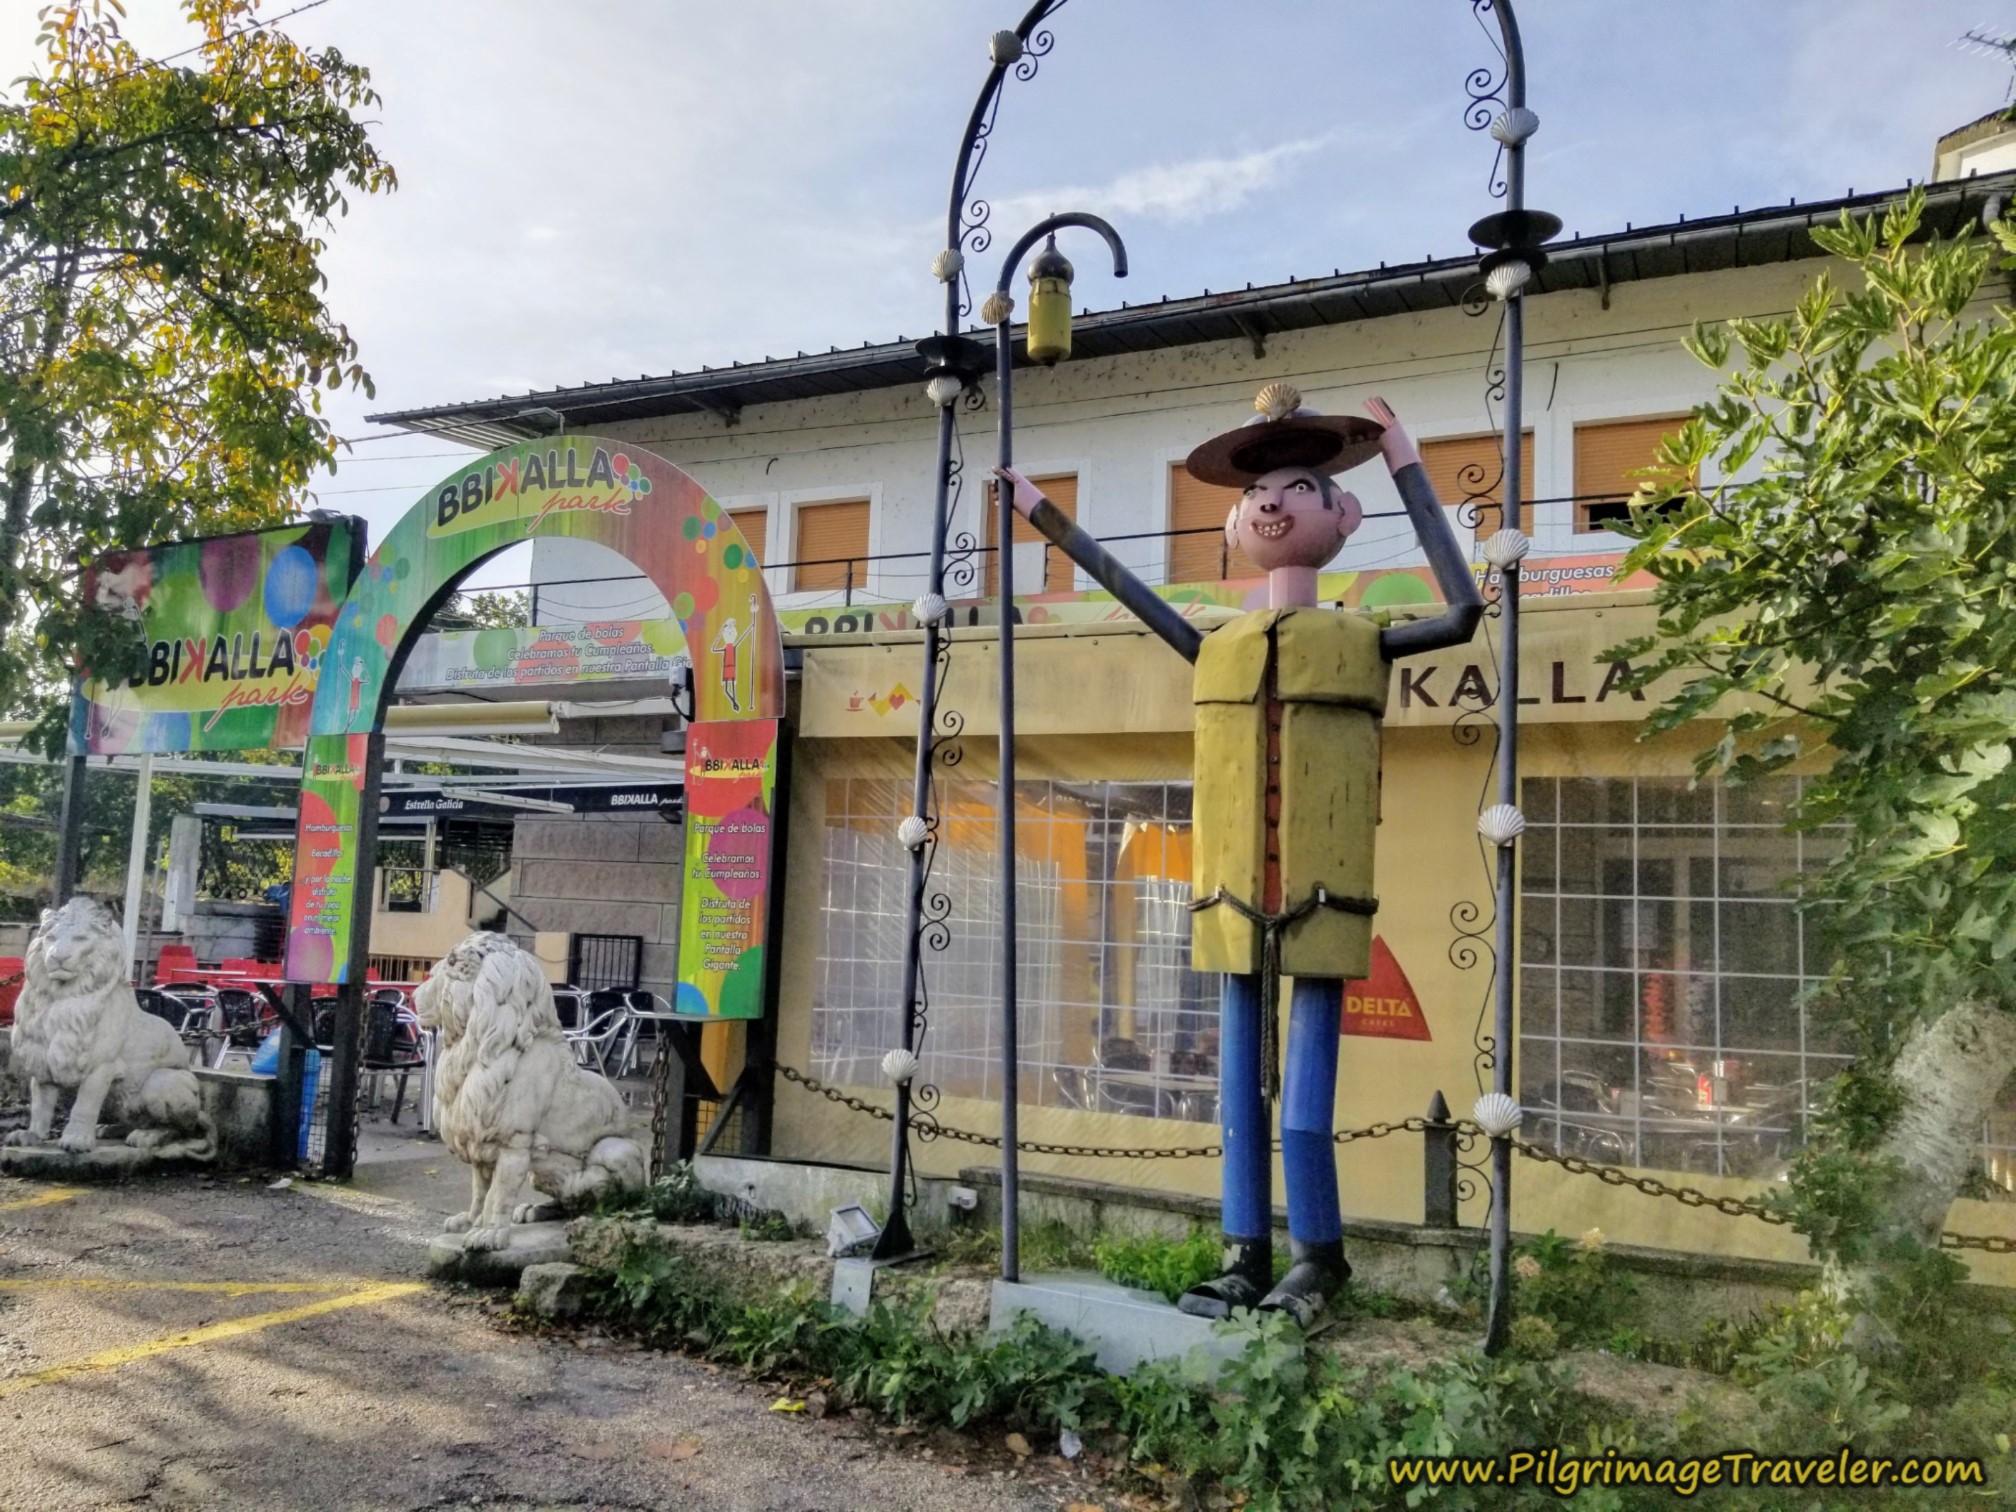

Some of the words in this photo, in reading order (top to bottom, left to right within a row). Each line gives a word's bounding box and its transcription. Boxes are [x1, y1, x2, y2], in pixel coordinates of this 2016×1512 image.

[527, 487, 631, 533] park
[1474, 564, 1614, 583] Haburguesas
[538, 629, 576, 644] Parque
[578, 626, 591, 639] de
[595, 624, 624, 639] bolas
[507, 647, 568, 661] Celebramos
[572, 645, 582, 657] tu
[585, 641, 655, 660] Cumpleaños.
[446, 667, 485, 680] Disfruta
[487, 665, 501, 679] de
[503, 664, 518, 678] los
[520, 661, 562, 678] partidos
[565, 664, 579, 675] en
[580, 660, 621, 675] nuestra
[624, 656, 668, 672] Pantalla
[204, 671, 308, 732] park
[404, 800, 434, 810] Estrella
[435, 799, 463, 810] Galicia
[694, 823, 725, 835] Parque
[728, 822, 739, 833] de
[742, 822, 765, 833] bolas
[702, 853, 754, 863] Celebramos
[692, 868, 702, 878] tu
[701, 897, 736, 909] Disfruta
[738, 898, 750, 909] de
[699, 912, 711, 924] los
[714, 913, 751, 926] partidos
[700, 930, 712, 938] en
[714, 930, 748, 940] nuestra
[704, 943, 741, 955] Pantalla
[703, 958, 741, 971] Gigante.
[1346, 996, 1413, 1017] DELTA
